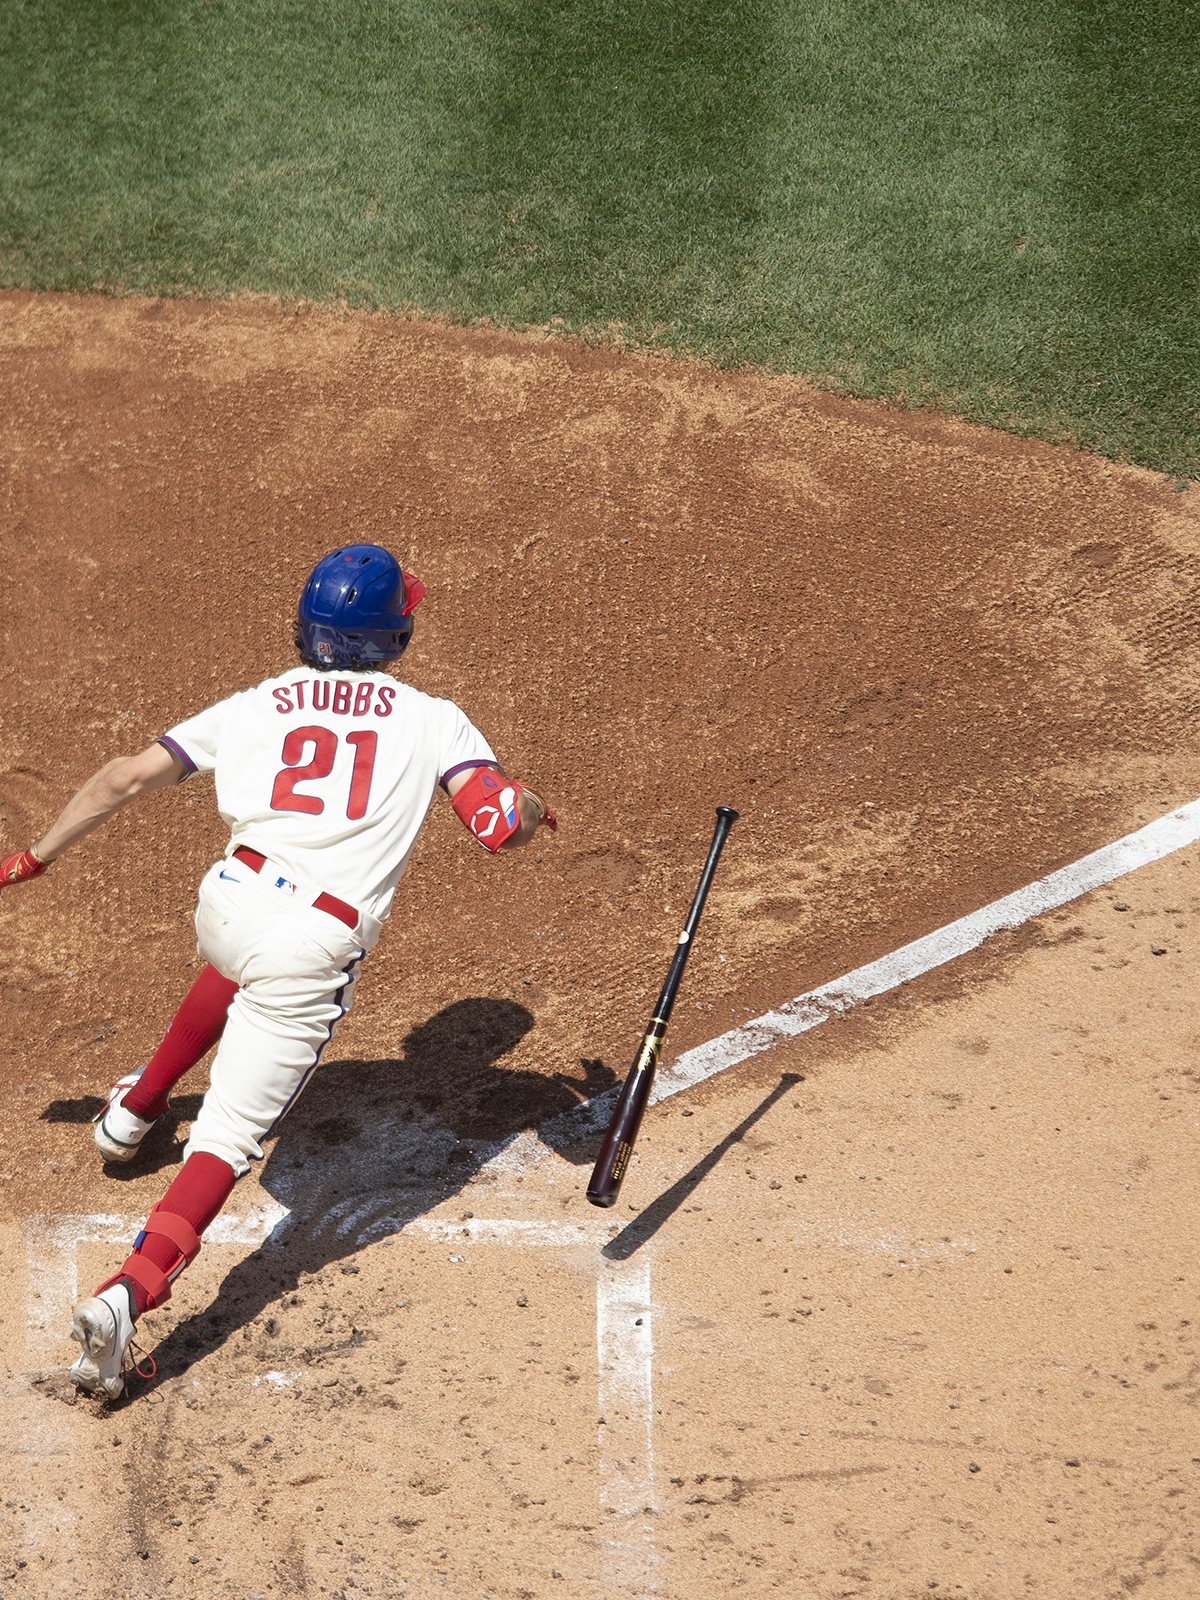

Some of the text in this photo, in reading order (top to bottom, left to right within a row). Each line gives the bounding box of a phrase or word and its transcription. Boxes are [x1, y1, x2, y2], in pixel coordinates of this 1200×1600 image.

[318, 641, 332, 655] 21
[272, 679, 396, 717] STUBBS
[270, 725, 378, 820] 21
